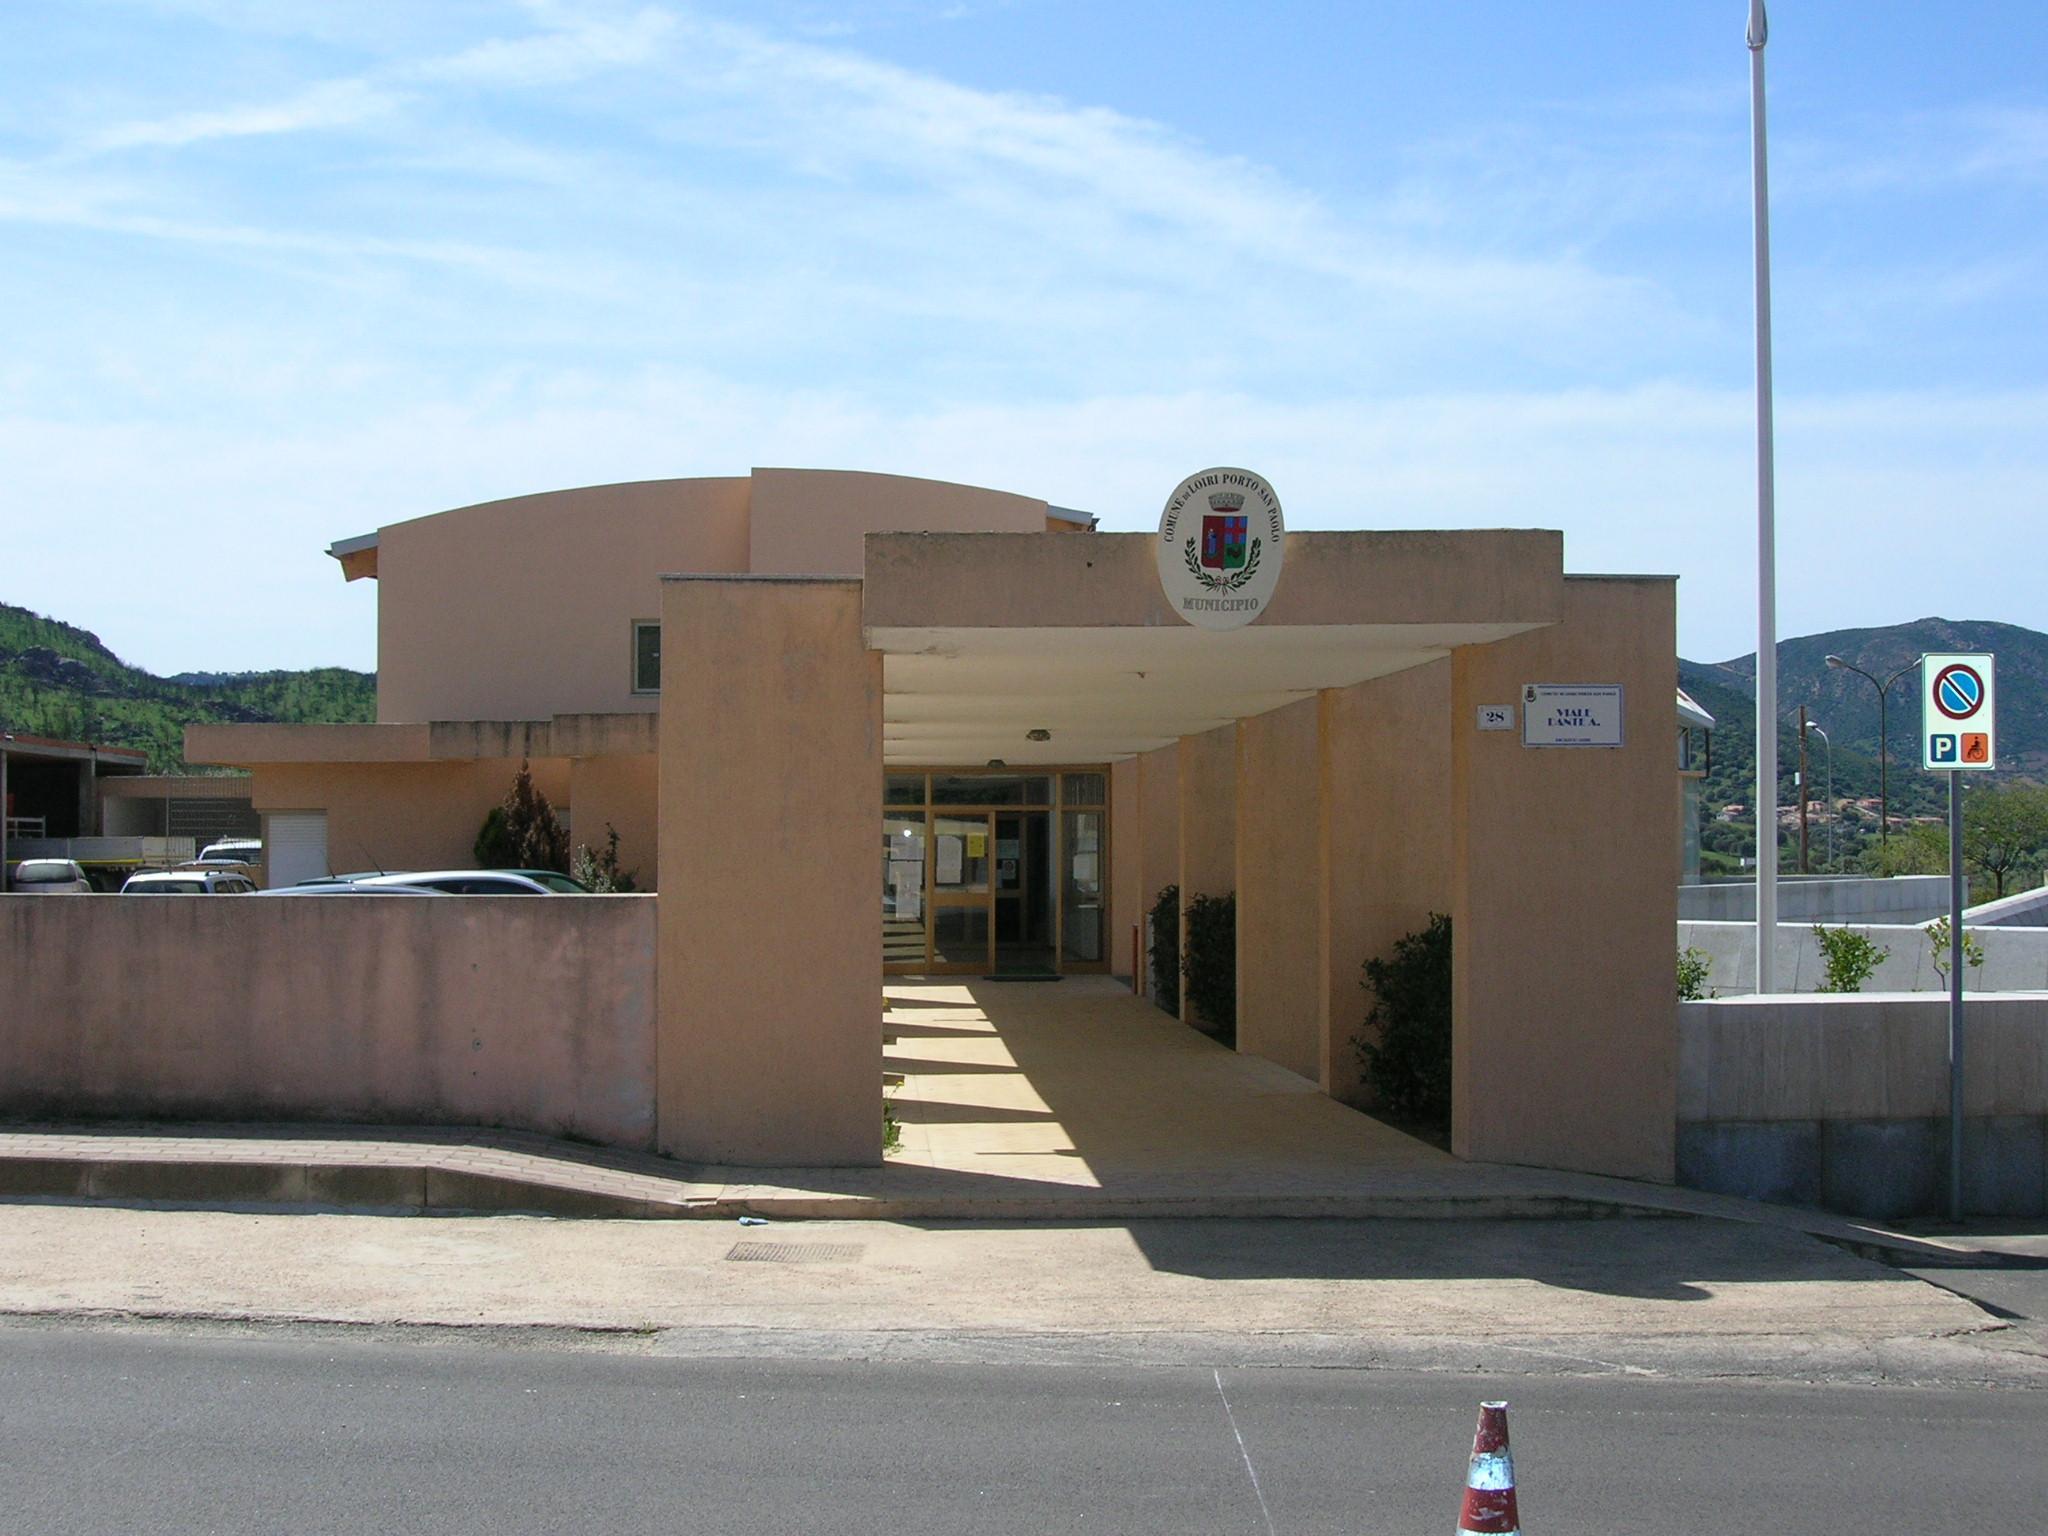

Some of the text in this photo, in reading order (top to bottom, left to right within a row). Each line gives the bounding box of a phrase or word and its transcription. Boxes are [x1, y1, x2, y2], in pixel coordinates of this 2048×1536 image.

[1164, 498, 1185, 543] COMUNE
[1187, 474, 1218, 494] LOIRI
[1222, 473, 1259, 491] PORTO
[1257, 487, 1274, 508] SAN
[1267, 507, 1280, 543] PAOLO
[1183, 597, 1259, 611] MUNICIPIO
[1486, 711, 1505, 723] 28
[1935, 737, 1952, 759] P
